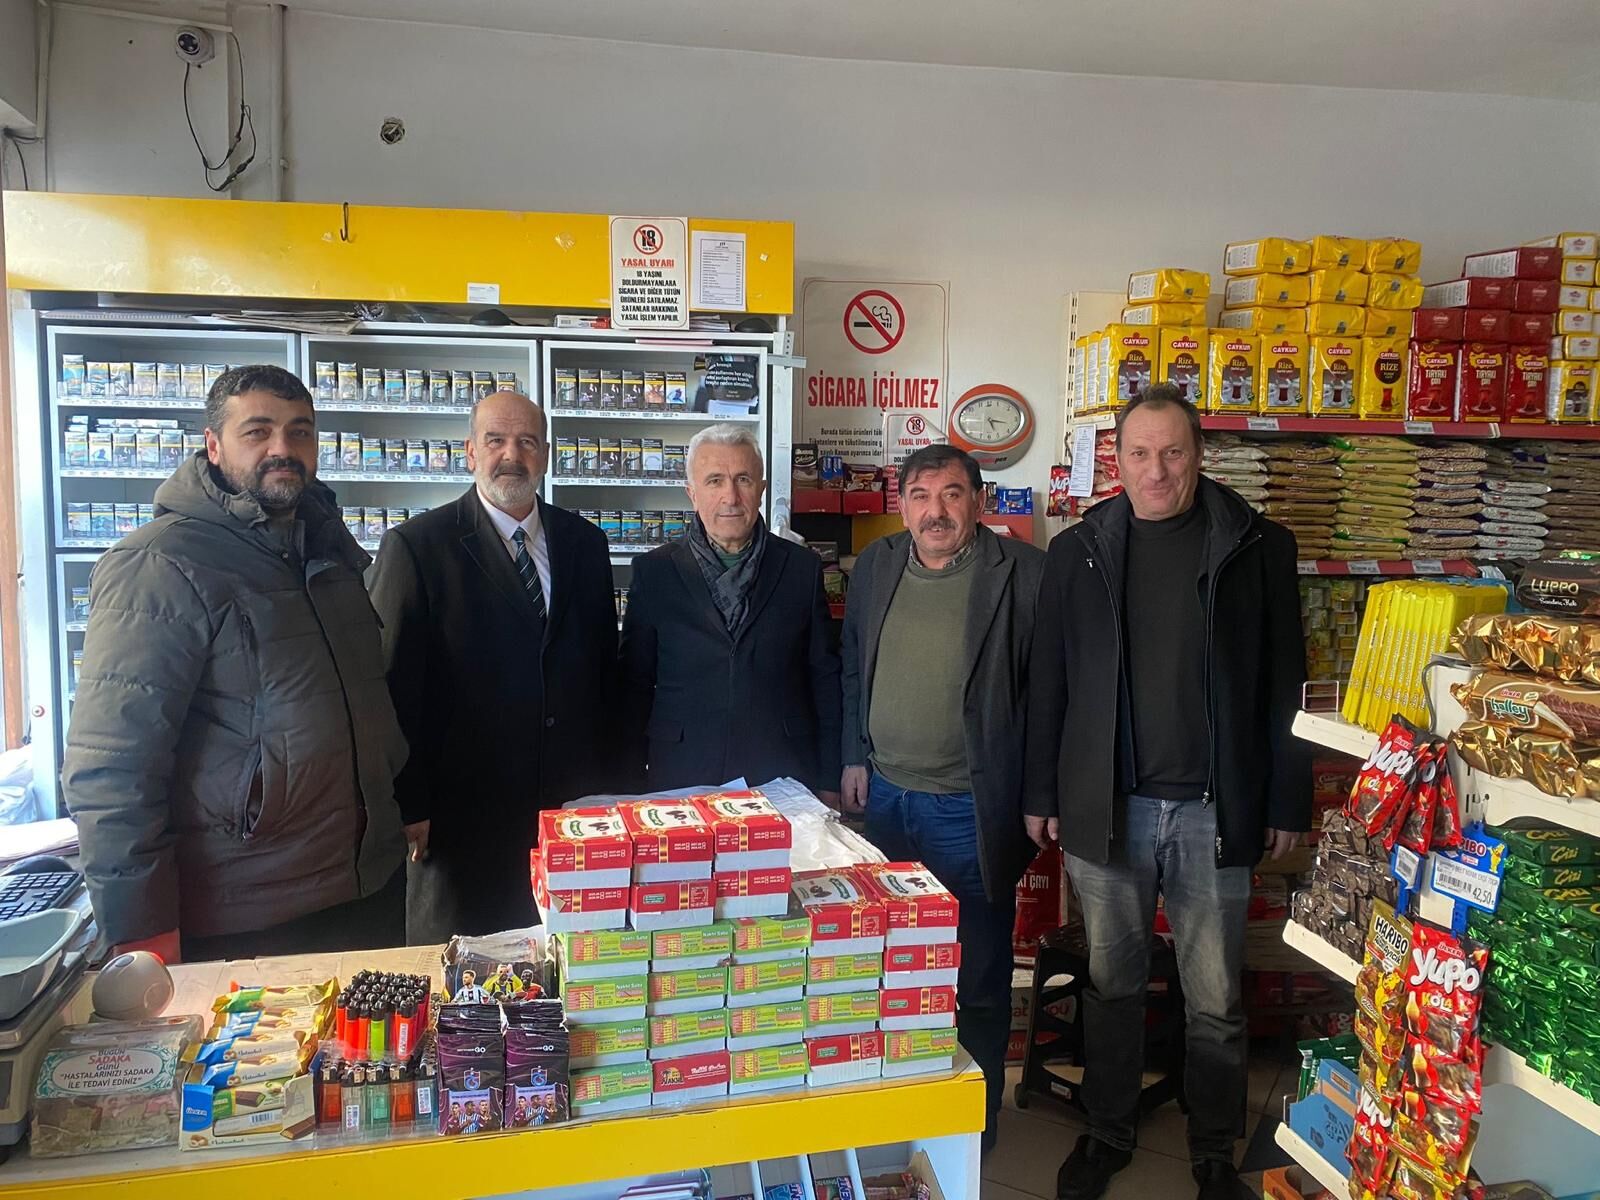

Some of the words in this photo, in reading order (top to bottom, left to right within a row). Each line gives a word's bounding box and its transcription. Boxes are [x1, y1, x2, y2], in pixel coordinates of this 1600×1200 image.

[621, 258, 647, 268] YASAL
[650, 258, 674, 268] UYARI
[636, 270, 642, 278] 18
[644, 270, 662, 278] YAŞINI
[622, 279, 676, 287] DOLDURMAYANLARA
[618, 287, 638, 295] SİGARA
[664, 288, 680, 296] TÜTÜN
[620, 296, 646, 304] ÜRÜNLERİ
[640, 314, 656, 322] İŞLEM
[808, 370, 868, 408] SİGARA
[873, 371, 938, 412] İÇİLMEZ
[820, 428, 838, 436] Burada
[898, 438, 914, 446] YASAL
[1531, 578, 1579, 595] LUPPO
[1491, 697, 1530, 724] halley
[1362, 740, 1414, 778] Yupo
[1030, 875, 1048, 891] ÇAYI
[1374, 914, 1410, 956] HARIBO
[1410, 948, 1480, 994] Yupo
[1422, 992, 1453, 1012] KOLA
[88, 1055, 132, 1065] SADAKA
[124, 1068, 154, 1076] SADAKA
[68, 1080, 80, 1088] İLE
[83, 1078, 110, 1088] TEDAVİ
